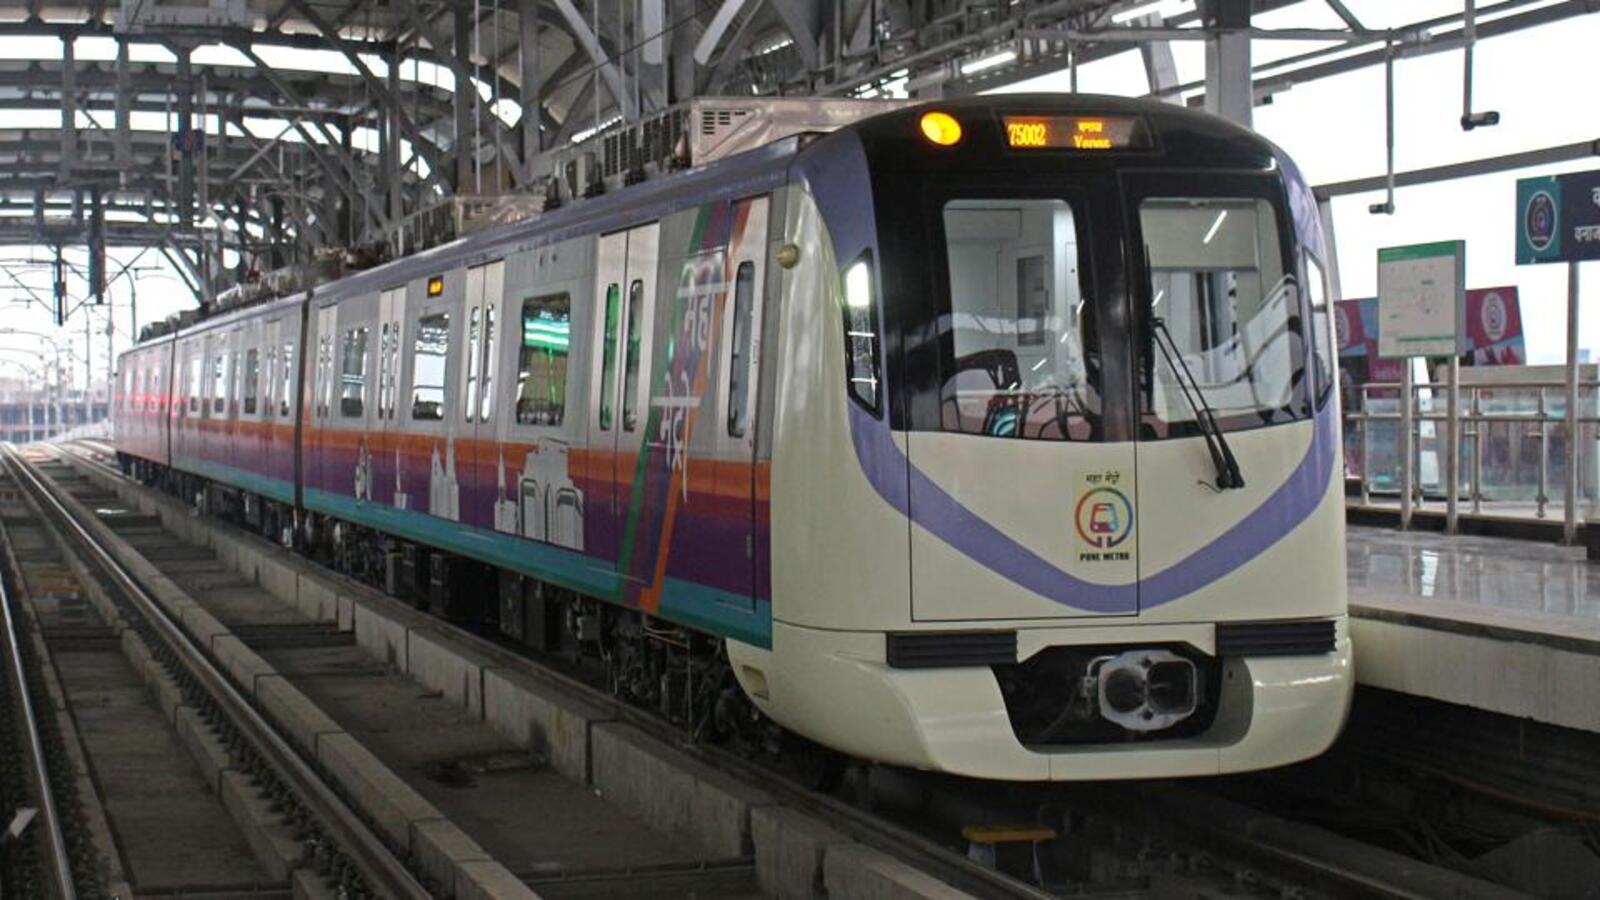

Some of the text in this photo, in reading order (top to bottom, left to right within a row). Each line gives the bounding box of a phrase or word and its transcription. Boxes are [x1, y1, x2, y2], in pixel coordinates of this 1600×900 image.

[1008, 123, 1046, 146] 75002
[1080, 551, 1129, 561] PUNE METRO
